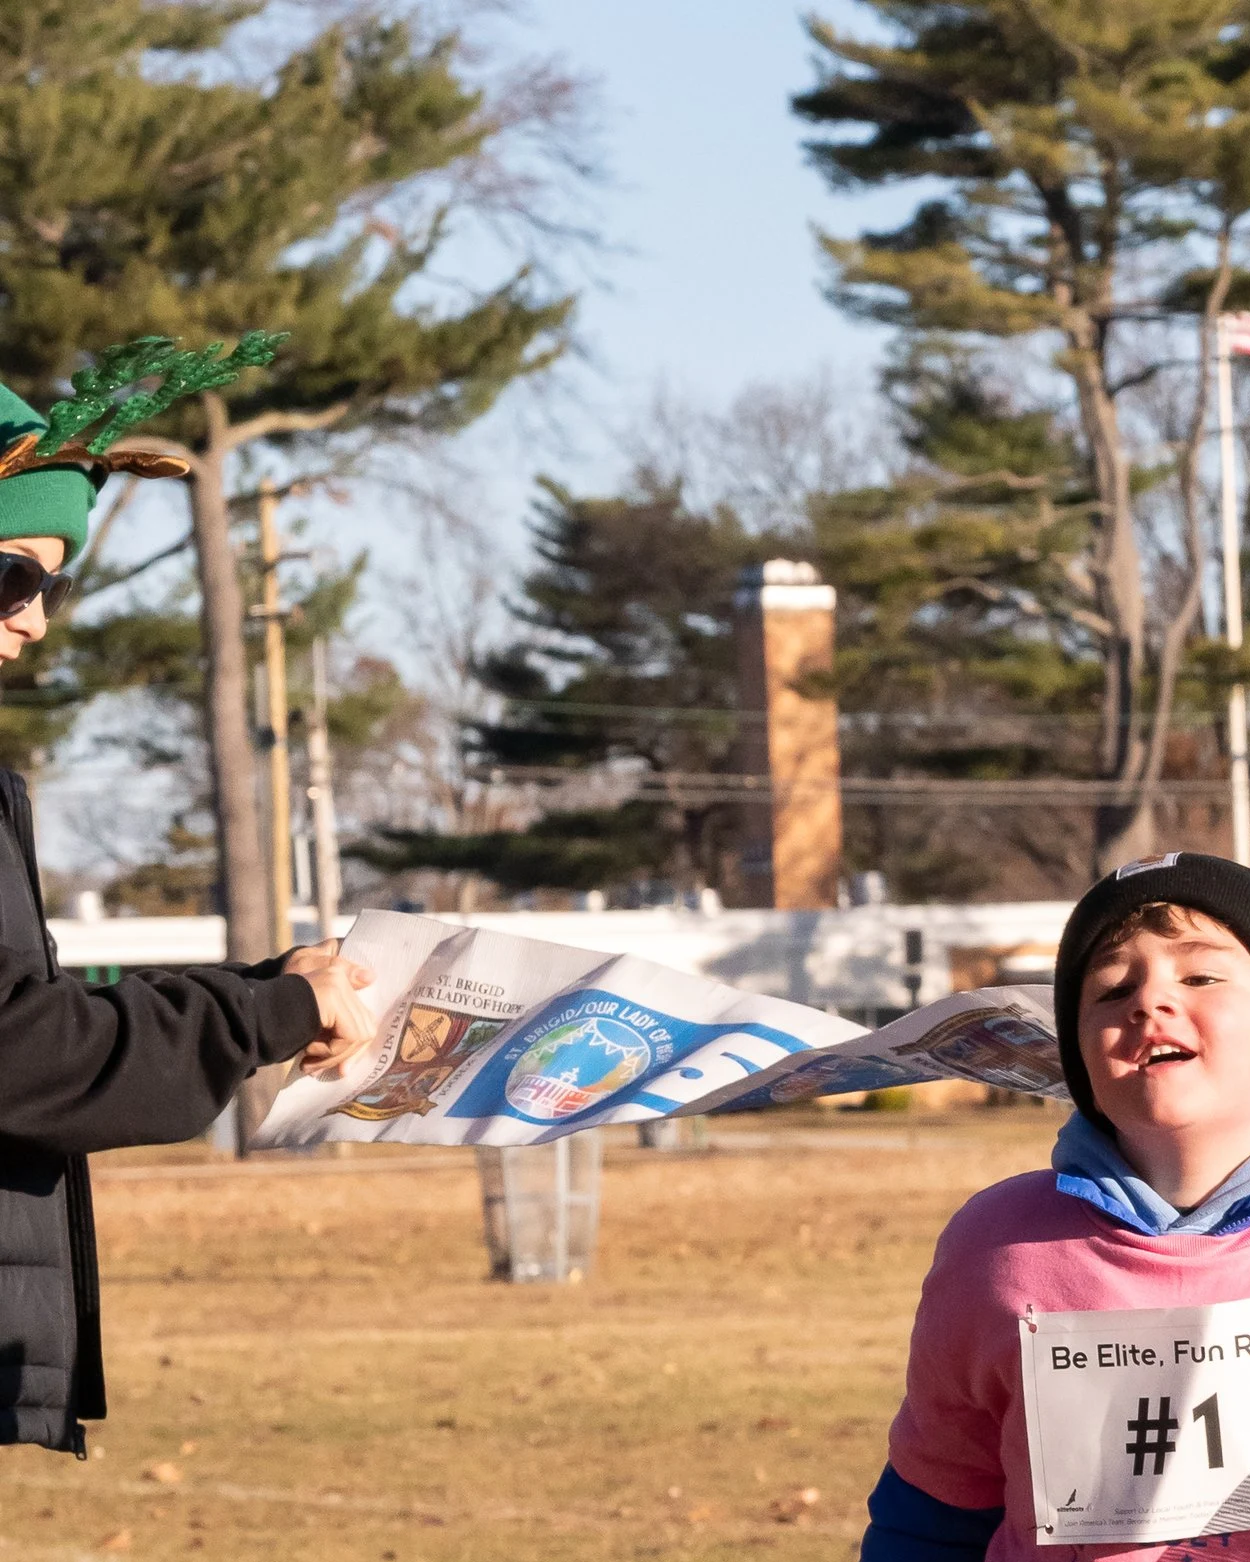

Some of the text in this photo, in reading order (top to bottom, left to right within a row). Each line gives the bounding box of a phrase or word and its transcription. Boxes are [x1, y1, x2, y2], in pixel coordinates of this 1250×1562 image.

[436, 988, 471, 1006] LADY
[472, 996, 491, 1010] OF
[455, 977, 505, 998] BRIGID
[618, 1004, 659, 1031] LADY
[1051, 1345, 1088, 1371] Be
[1097, 1343, 1165, 1369] Elite,
[1173, 1340, 1225, 1365] Fun
[1126, 1391, 1225, 1476] #1
